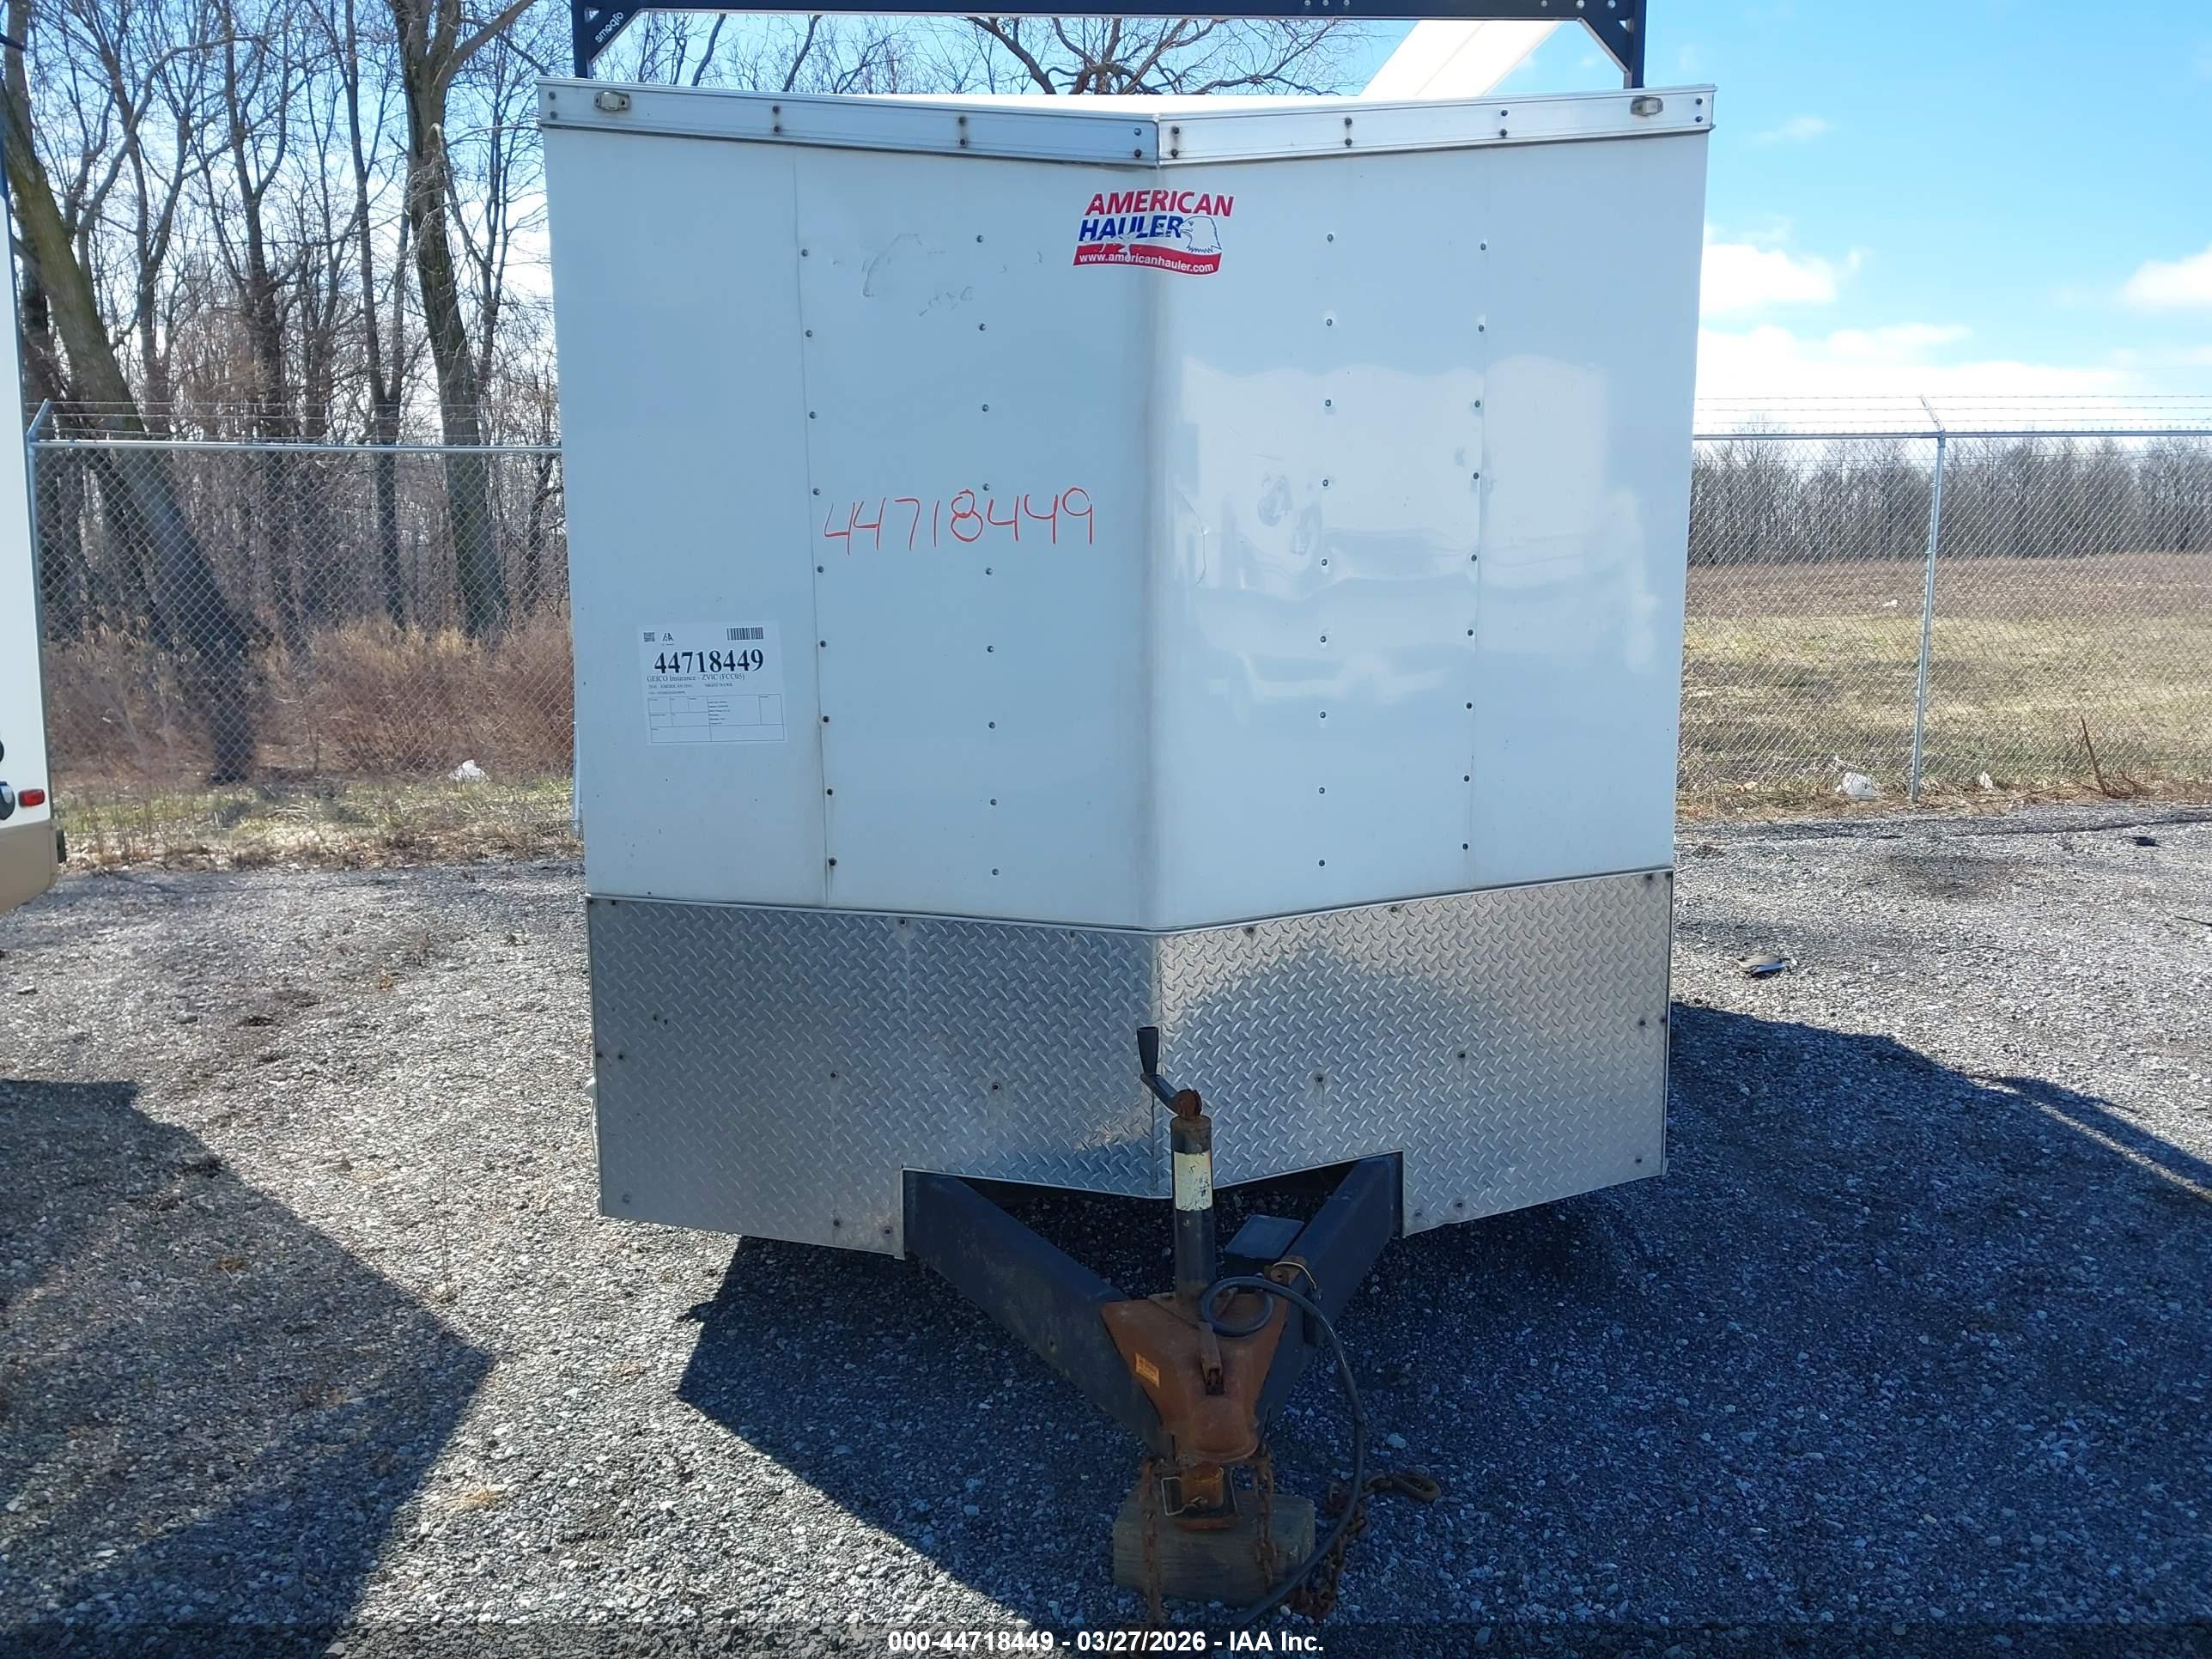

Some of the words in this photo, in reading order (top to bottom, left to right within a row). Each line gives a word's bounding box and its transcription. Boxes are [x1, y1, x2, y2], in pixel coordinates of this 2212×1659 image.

[1085, 189, 1235, 217] AMERICAN
[1078, 215, 1184, 242] HAULER
[1079, 252, 1214, 273] www.americanhauler.com
[823, 487, 1093, 556] 44718449
[653, 649, 764, 674] 44718449
